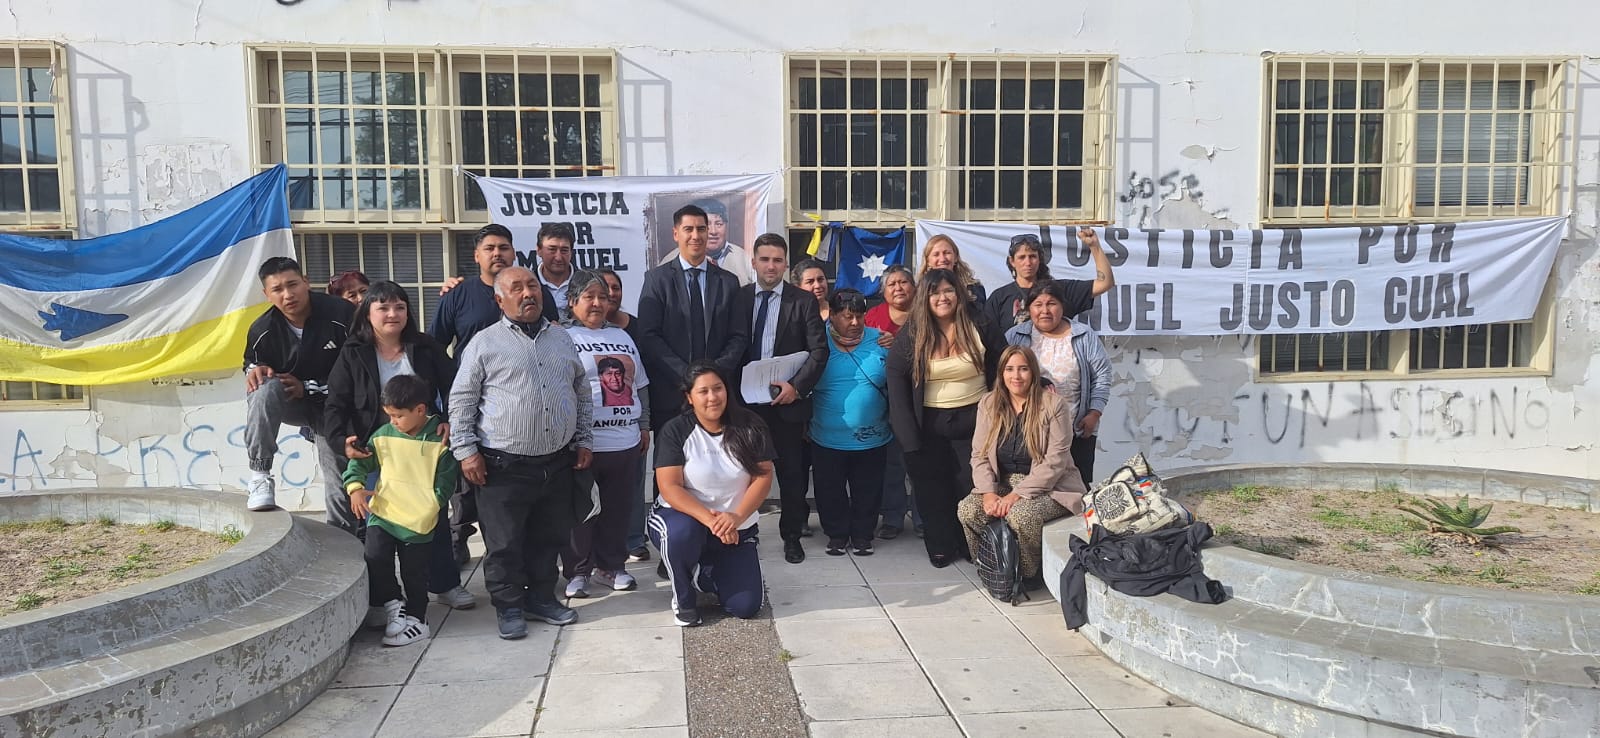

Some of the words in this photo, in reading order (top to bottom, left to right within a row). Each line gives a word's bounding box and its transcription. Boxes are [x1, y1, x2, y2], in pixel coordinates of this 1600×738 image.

[500, 192, 629, 216] JUSTICIA
[1039, 225, 1303, 269] JUSTICIA
[1358, 223, 1456, 265] POR
[516, 248, 628, 274] MUEL
[1219, 279, 1355, 331] JUSTO
[1384, 272, 1474, 324] CUAL
[593, 419, 627, 428] ANUEL
[613, 407, 631, 415] POR
[0, 429, 46, 490] A
